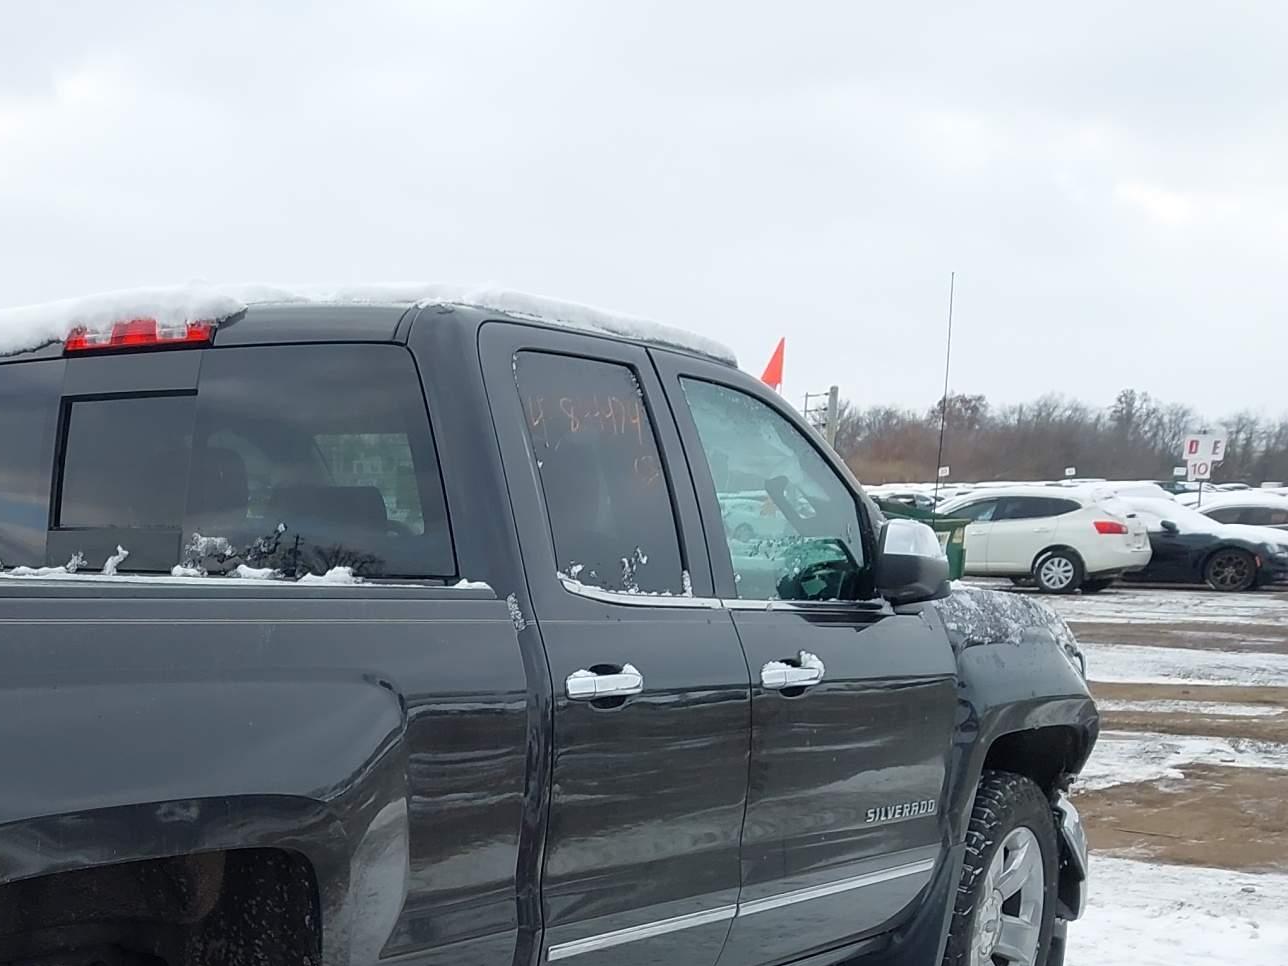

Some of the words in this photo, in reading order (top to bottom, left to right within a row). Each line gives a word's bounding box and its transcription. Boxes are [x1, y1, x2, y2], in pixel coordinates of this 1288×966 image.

[1188, 440, 1200, 454] D
[1212, 440, 1221, 455] E
[1192, 463, 1209, 475] 10
[865, 799, 936, 823] SILVERADO
